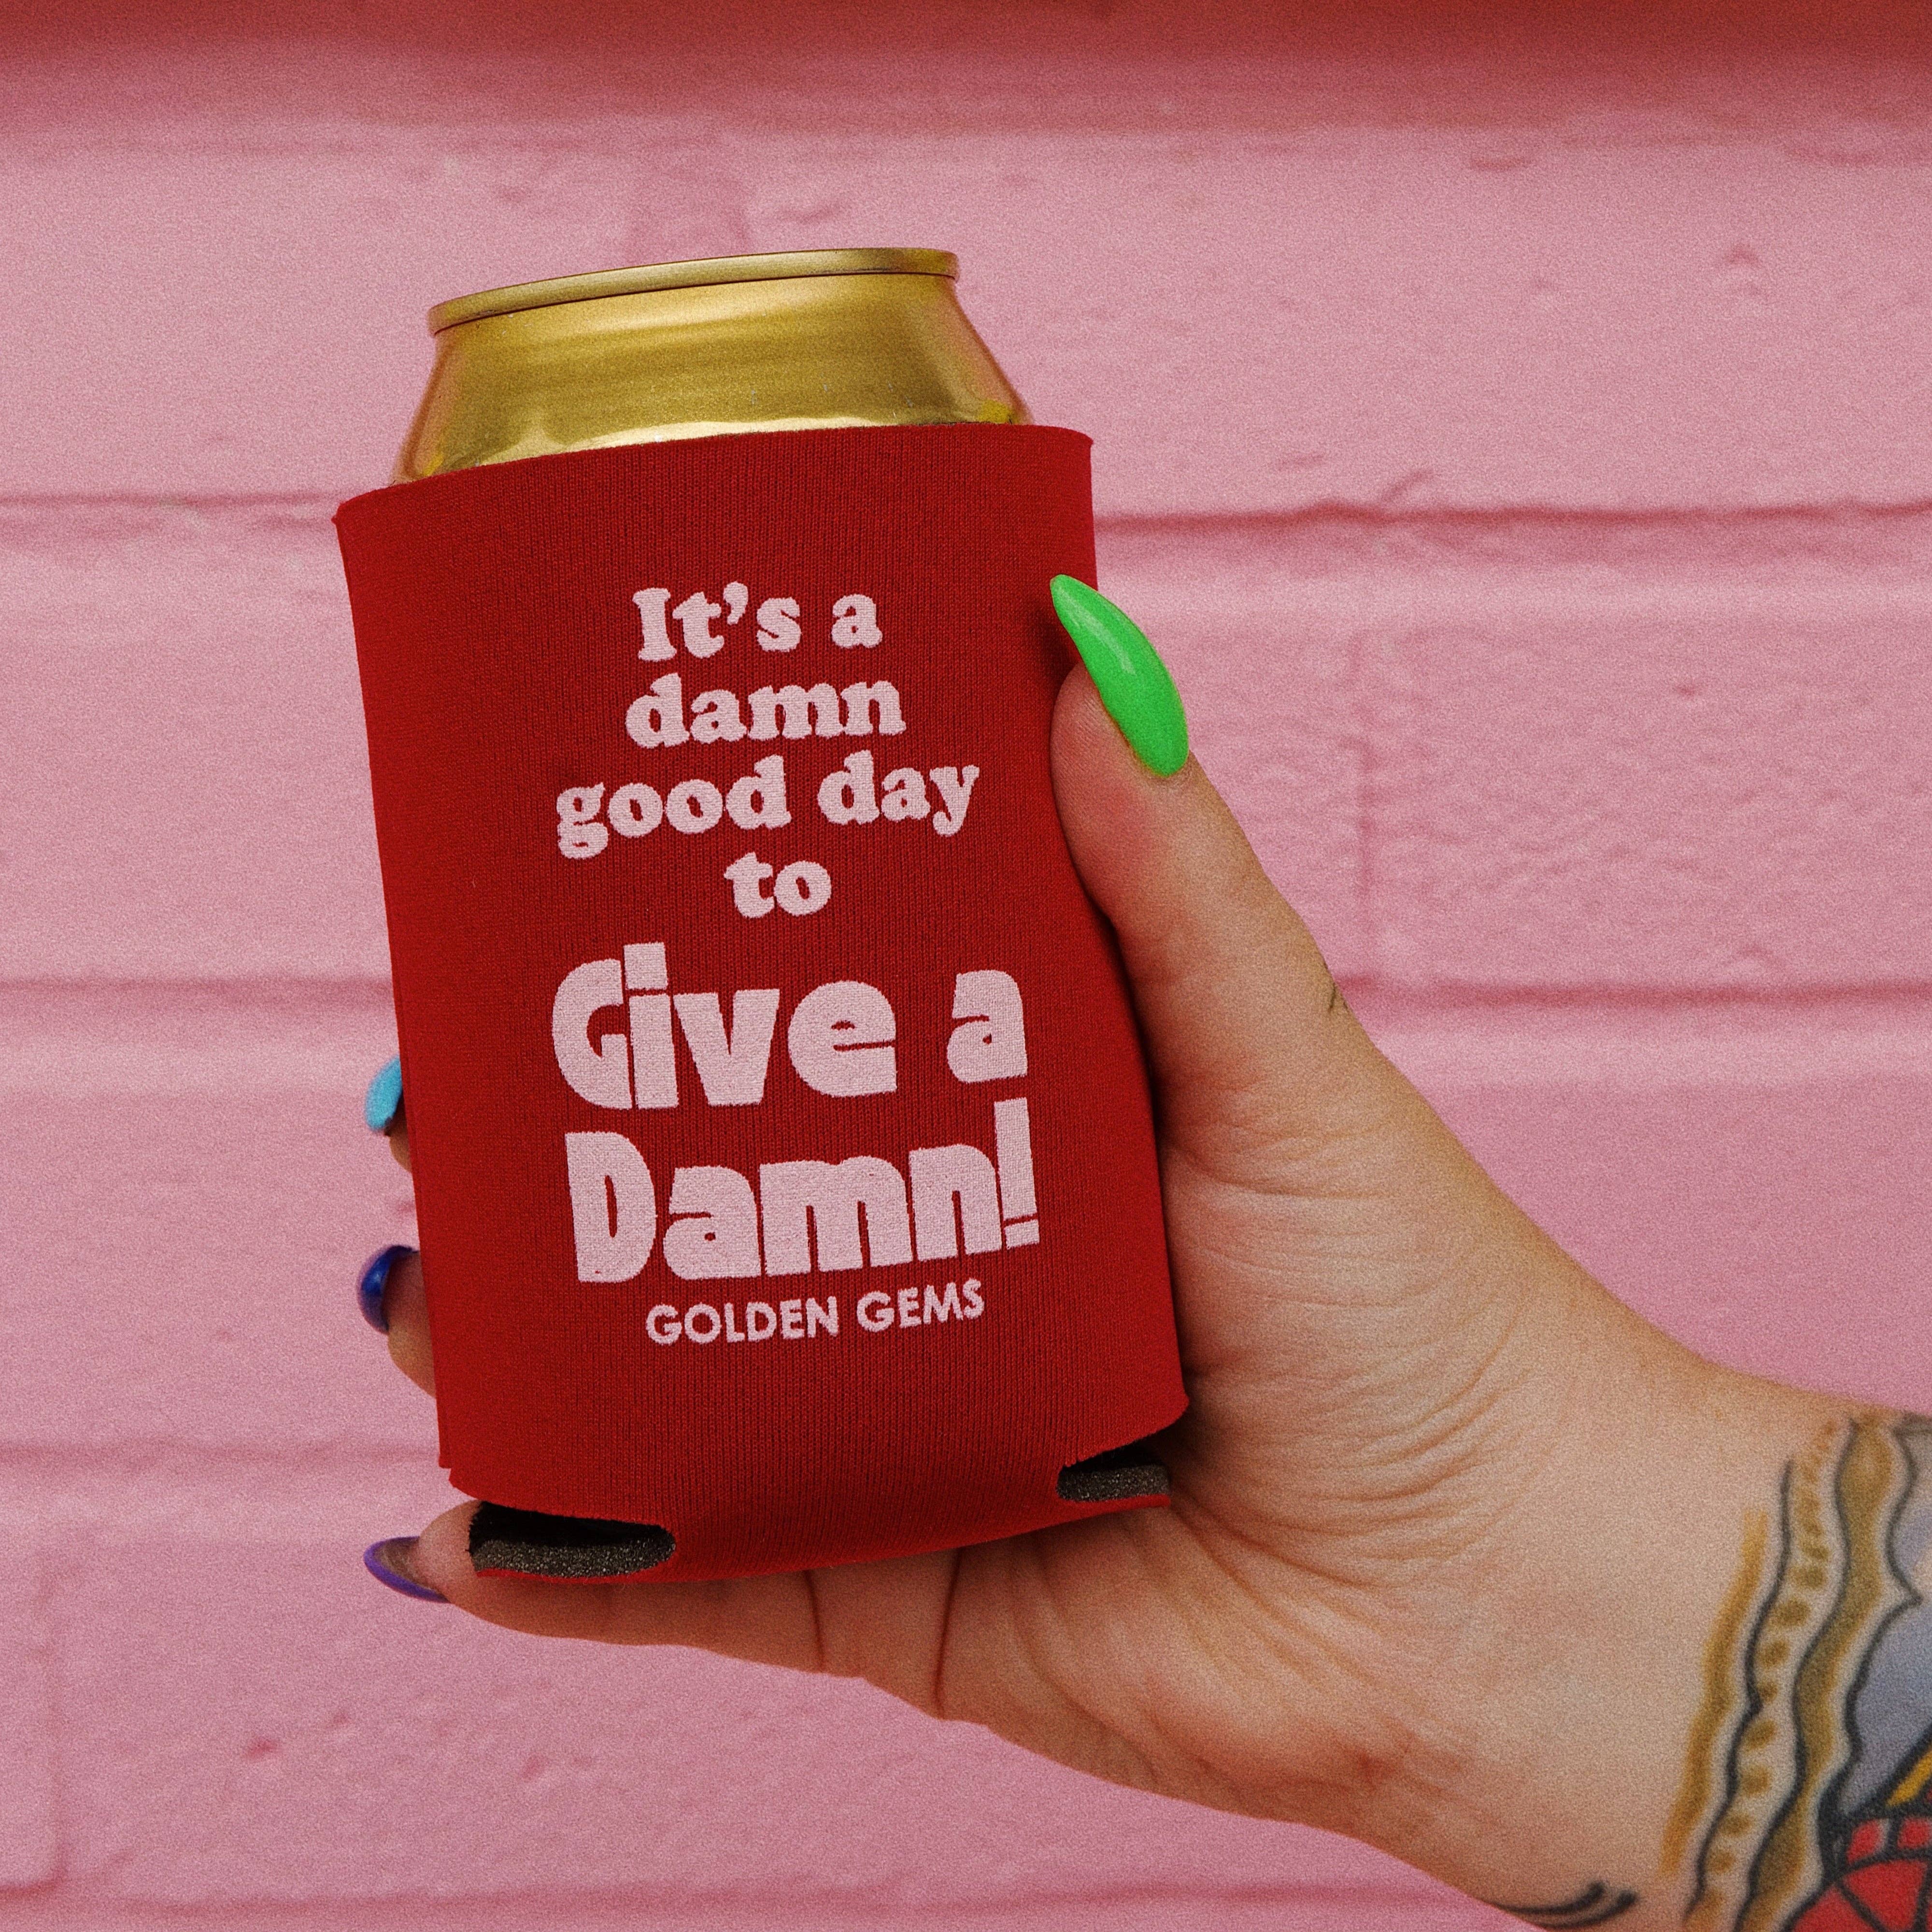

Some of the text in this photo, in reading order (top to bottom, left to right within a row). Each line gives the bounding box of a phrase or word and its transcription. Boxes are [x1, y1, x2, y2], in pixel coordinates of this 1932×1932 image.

[831, 594, 882, 648] a
[625, 672, 906, 748] damn
[556, 750, 980, 859] good day
[724, 852, 832, 918] to
[552, 942, 1028, 1109] Give a
[565, 1097, 1039, 1282] Damn!
[646, 1278, 984, 1344] GOLDEN GEMS
